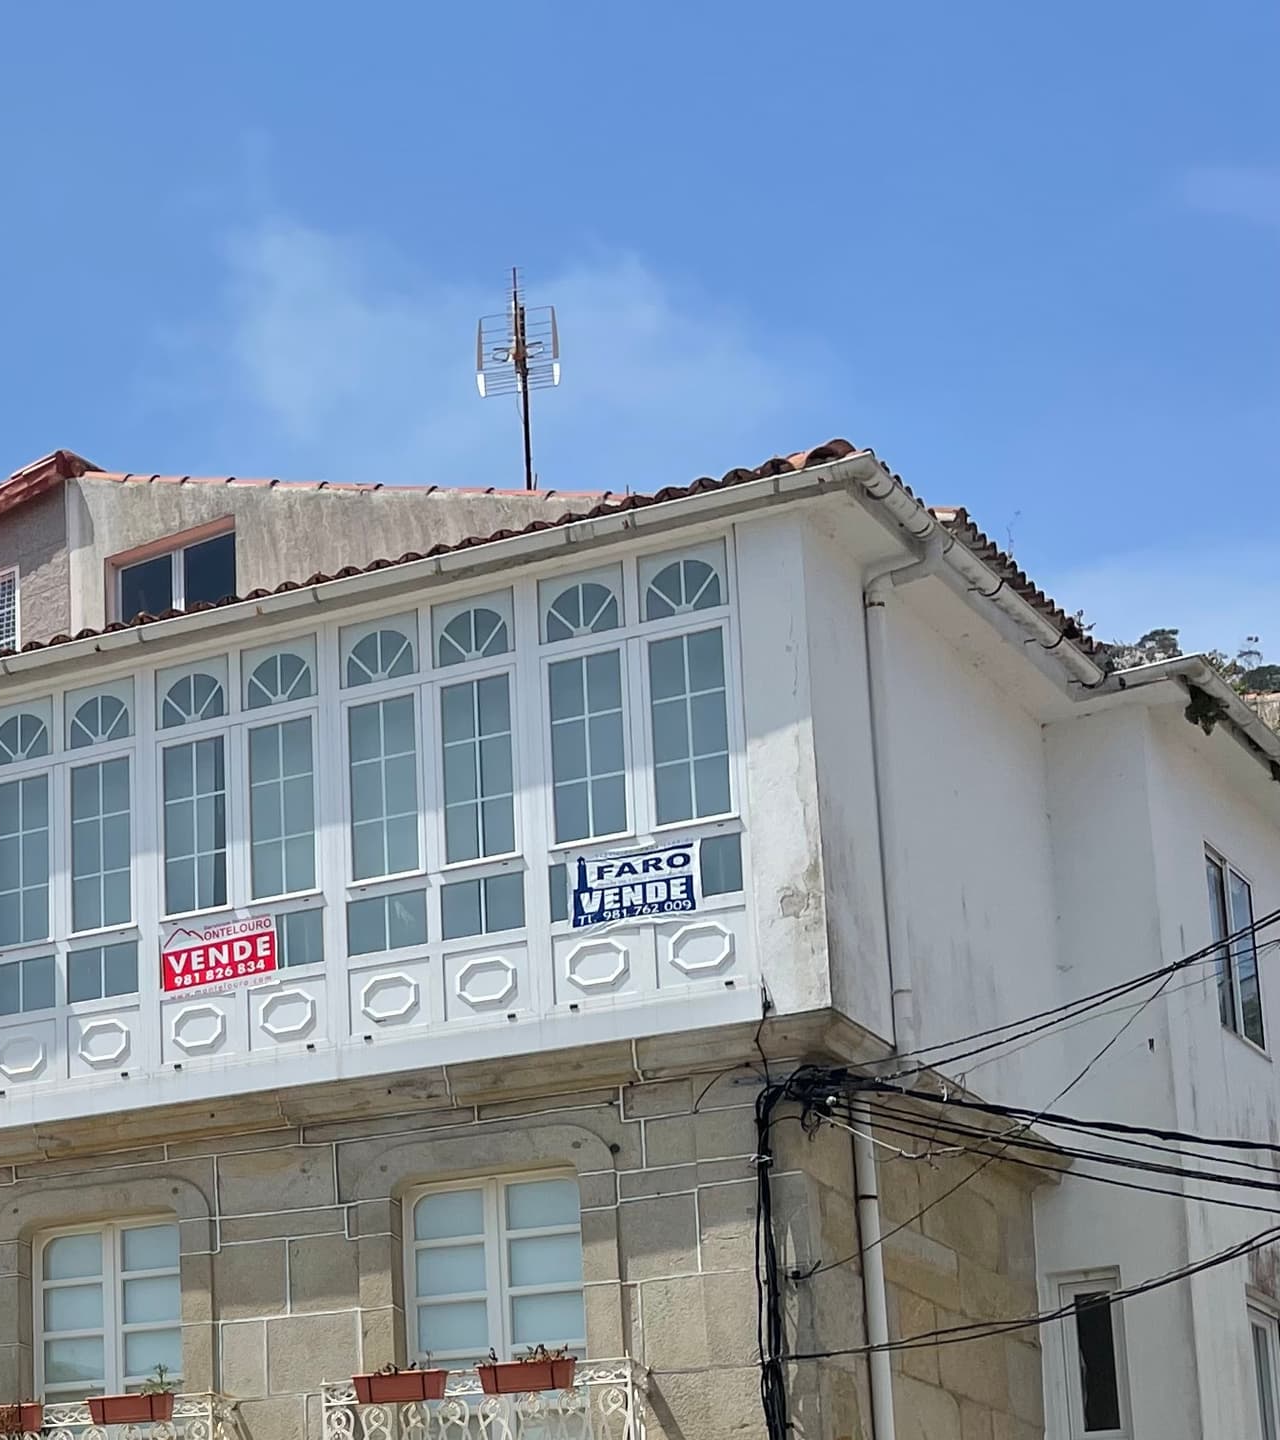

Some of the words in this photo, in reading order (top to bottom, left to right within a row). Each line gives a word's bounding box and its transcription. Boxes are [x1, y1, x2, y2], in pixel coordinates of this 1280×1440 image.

[597, 852, 691, 881] FARO
[580, 877, 689, 914] VENDE
[603, 908, 628, 921] 981
[635, 904, 660, 917] 762
[664, 899, 692, 911] 009
[168, 935, 272, 974] VENDE
[174, 972, 200, 987] 981
[205, 967, 233, 982] 826
[237, 959, 266, 975] 834
